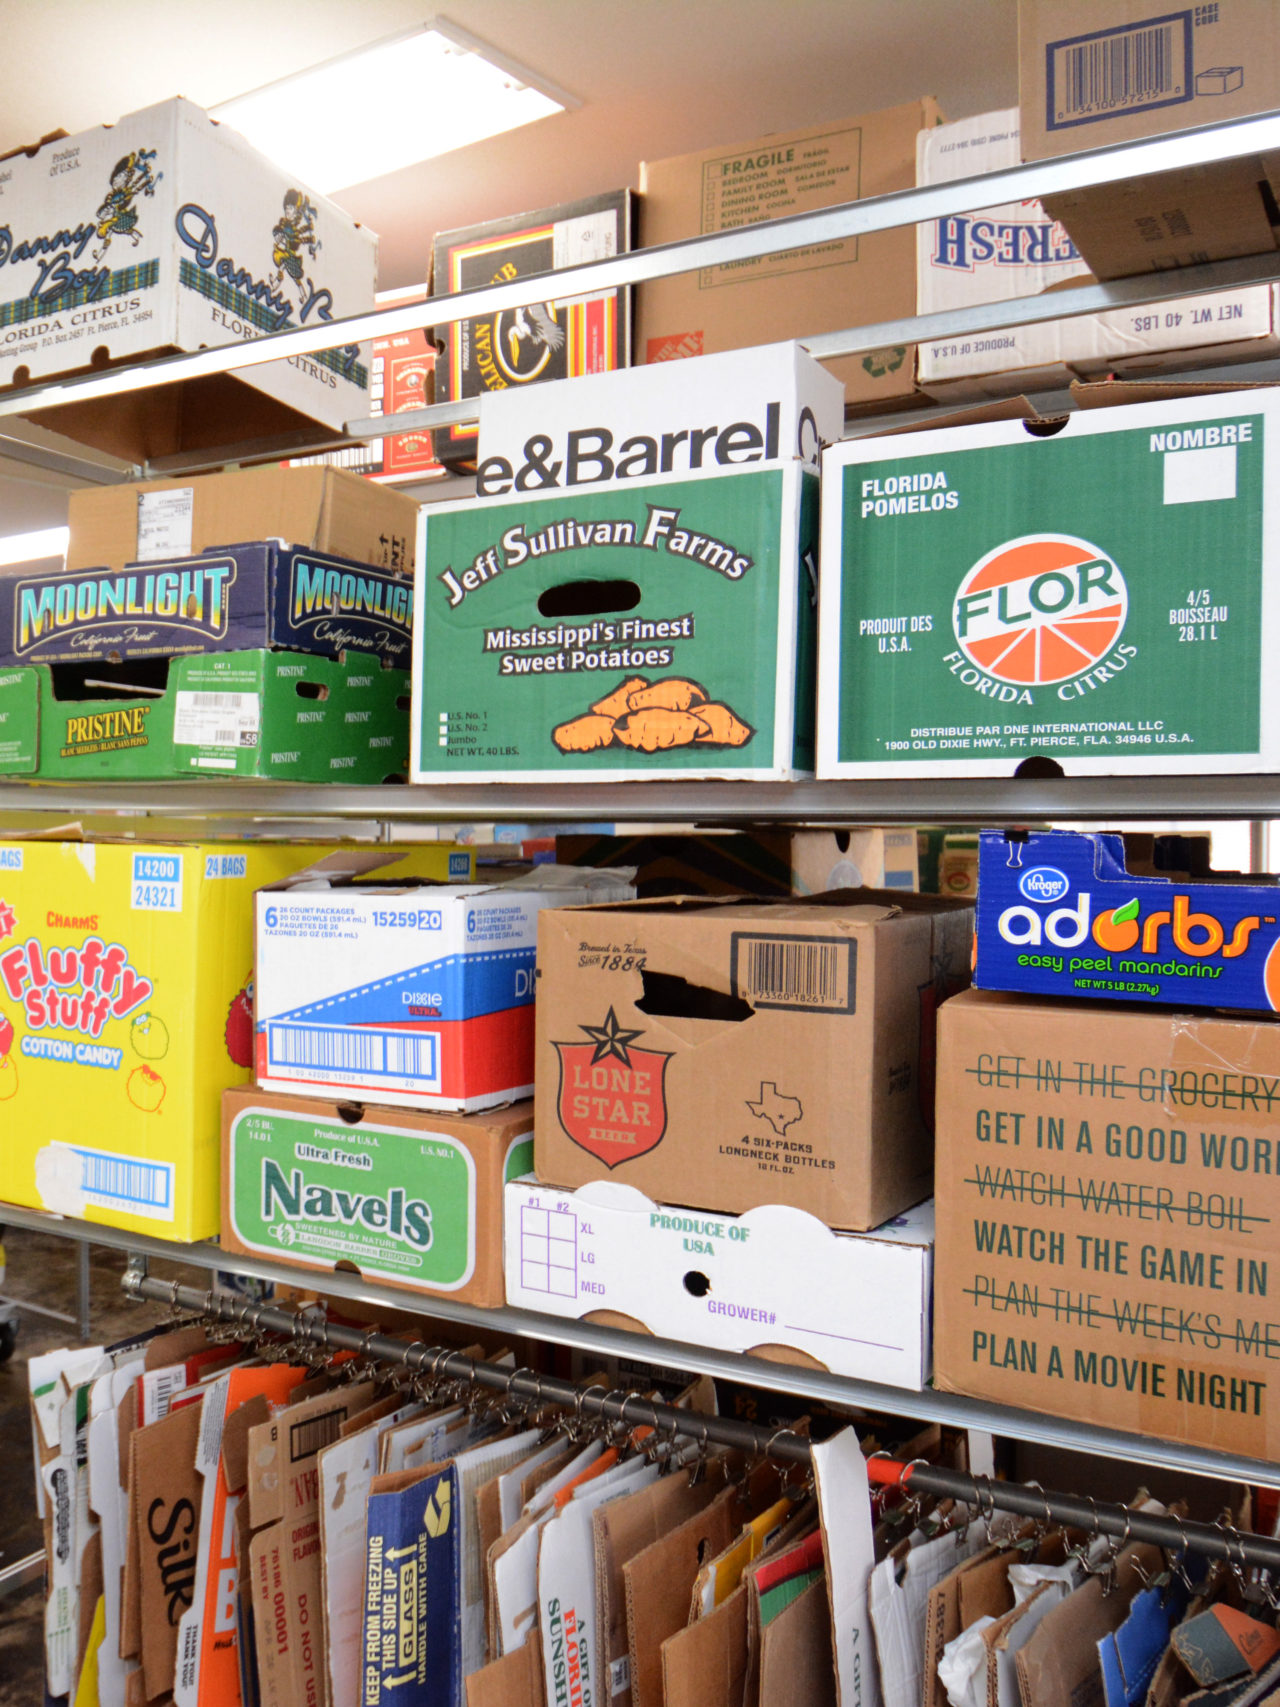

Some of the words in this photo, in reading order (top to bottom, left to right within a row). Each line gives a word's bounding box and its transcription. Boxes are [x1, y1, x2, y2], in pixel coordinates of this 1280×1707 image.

[1195, 3, 1219, 17] CASE
[1195, 13, 1219, 26] CODE
[52, 146, 81, 164] Produce
[722, 148, 795, 176] FRAGILE
[721, 171, 768, 187] BEDROOM
[721, 184, 754, 198] FAMILY
[755, 178, 786, 190] ROOM
[721, 195, 756, 209] DINING
[758, 188, 789, 201] ROOM
[721, 205, 760, 219] KITCHEN
[934, 216, 1080, 270] FRESH
[29, 250, 111, 304] Boy
[175, 203, 294, 331] Danny
[71, 297, 141, 326] CITRUS
[1131, 315, 1160, 332] LBS.
[1165, 313, 1183, 327] 40
[1191, 308, 1213, 324] WT.
[1217, 303, 1243, 321] NET
[974, 336, 1016, 353] PRODUCE
[1149, 423, 1253, 453] NOMBRE
[861, 471, 947, 498] FLORIDA
[860, 490, 959, 519] POMELOS
[438, 547, 500, 607] Jeff
[501, 520, 636, 568] Sullivan
[643, 504, 755, 580] Farms
[19, 566, 231, 650] MOONLIGHT
[957, 557, 1119, 640] FLOR
[1186, 589, 1210, 607] 4/5
[859, 618, 908, 636] PRODUIT
[909, 615, 933, 633] DES
[1169, 607, 1229, 626] BOISSEAU
[484, 622, 616, 653] Mississippi's
[619, 612, 695, 641] Finest
[878, 636, 912, 654] U.S.A.
[1178, 626, 1206, 642] 28.1
[498, 652, 567, 675] Sweet
[570, 645, 674, 672] Potatoes
[942, 649, 1034, 706] FLORIDA
[1056, 642, 1138, 702] CITRUS
[66, 707, 146, 745] PRISTINE
[910, 725, 975, 738] DISTRIBUE
[976, 724, 1002, 736] PAR
[1003, 724, 1030, 736] DNE
[1032, 720, 1136, 735] INTERNATIONAL
[1137, 720, 1164, 732] LLC
[446, 747, 465, 757] NET
[486, 746, 498, 756] 40
[884, 740, 910, 751] 1900
[912, 739, 937, 750] OLD
[939, 738, 971, 750] DIXIE
[1009, 736, 1028, 748] FT.
[1030, 735, 1080, 749] PIERCE,
[1082, 735, 1112, 746] FLA.
[1114, 734, 1152, 745] 34946
[1154, 732, 1194, 744] U.S.A.
[137, 859, 176, 878] 14200
[205, 858, 219, 876] 24
[220, 856, 246, 876] BAGS
[135, 885, 177, 908] 24321
[1027, 873, 1063, 897] Kroger
[46, 911, 99, 931] CHARMS
[265, 906, 278, 929] 6
[316, 907, 355, 915] PACKAGES
[372, 911, 417, 928] 15259
[466, 909, 476, 934] 6
[0, 936, 154, 1021] Fluffy
[1017, 953, 1063, 973] easy
[1069, 955, 1113, 973] peel
[1119, 959, 1223, 979] mandarins
[1074, 978, 1091, 988] NET
[1092, 979, 1107, 989] WT
[1126, 981, 1160, 996] (2.27kg)
[24, 986, 112, 1038] Stuff
[21, 1035, 74, 1061] COTTON
[73, 1043, 123, 1070] CANDY
[573, 1064, 652, 1096] LONE
[977, 1053, 1026, 1090] GET
[1036, 1057, 1062, 1094] IN
[1073, 1061, 1127, 1100] THE
[1138, 1066, 1280, 1113] GROCERY
[573, 1096, 652, 1127] STAR
[314, 1127, 346, 1145] Produce
[753, 1136, 813, 1154] SIX-PACKS
[976, 1108, 1026, 1147] GET
[1036, 1115, 1065, 1152] IN
[1075, 1119, 1093, 1154] A
[1105, 1123, 1188, 1166] GOOD
[296, 1144, 330, 1161] Ultra
[333, 1149, 373, 1169] Fresh
[719, 1145, 781, 1163] LONGNECK
[784, 1153, 836, 1170] BOTTLES
[261, 1156, 433, 1250] Navels
[556, 1200, 569, 1213] #2
[975, 1163, 1066, 1209] WATCH
[1078, 1176, 1174, 1224] WATER
[1186, 1190, 1255, 1234] BOIL
[295, 1221, 347, 1240] SWEETENED
[361, 1233, 398, 1250] NATURE
[580, 1222, 595, 1236] XL
[649, 1212, 726, 1239] PRODUCE
[727, 1224, 751, 1243] OF
[580, 1251, 596, 1265] LG
[683, 1237, 715, 1257] USA
[973, 1218, 1066, 1266] WATCH
[1076, 1234, 1130, 1276] THE
[1140, 1243, 1224, 1291] GAME
[1236, 1257, 1268, 1298] IN
[580, 1280, 607, 1297] MED
[974, 1274, 1039, 1319] PLAN
[1049, 1286, 1103, 1329] THE
[707, 1299, 778, 1327] GROWER#
[972, 1328, 1038, 1375] PLAN
[1047, 1344, 1065, 1379] A
[1074, 1347, 1166, 1398] MOVIE
[1176, 1366, 1268, 1417] NIGHT
[147, 1497, 196, 1627] Silk
[418, 1532, 428, 1574] CARE
[366, 1535, 383, 1611] FREEZING
[383, 1567, 398, 1591] UP
[297, 1593, 310, 1625] DO
[418, 1576, 428, 1619] WITH
[272, 1591, 290, 1657] 00001
[382, 1593, 398, 1631] SIDE
[403, 1567, 415, 1659] GLASS
[300, 1630, 315, 1672] NOT
[366, 1613, 381, 1662] FROM
[381, 1633, 397, 1672] THIS
[417, 1621, 427, 1685] HANDLE
[579, 1637, 590, 1682] GIFT
[365, 1665, 381, 1706] KEEP
